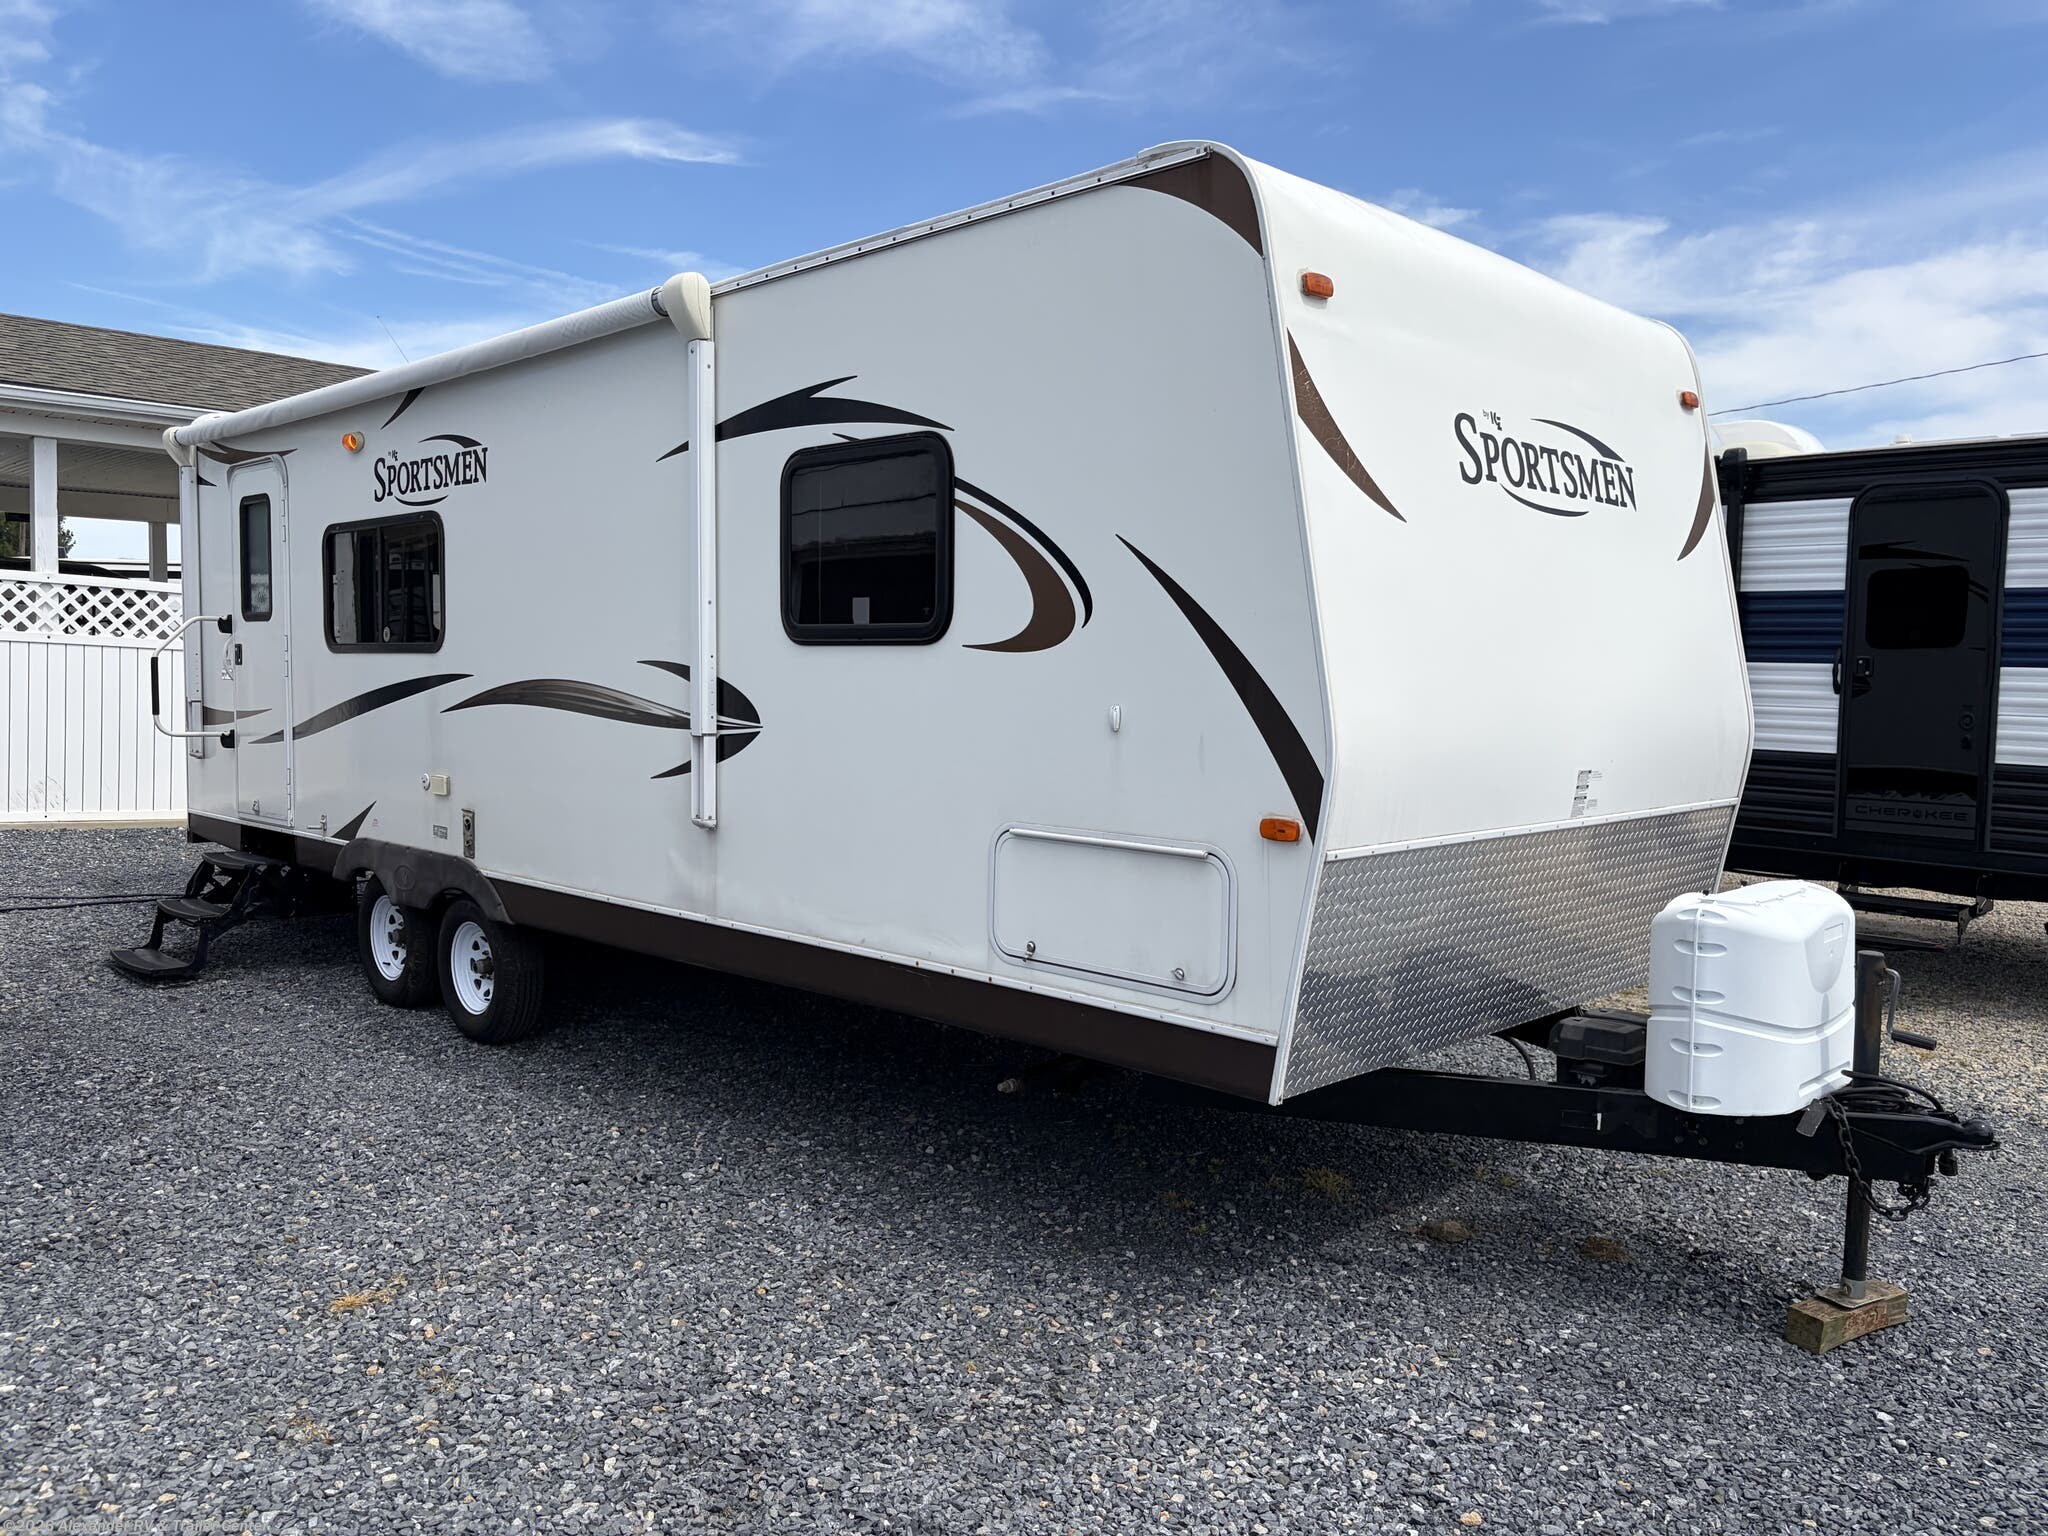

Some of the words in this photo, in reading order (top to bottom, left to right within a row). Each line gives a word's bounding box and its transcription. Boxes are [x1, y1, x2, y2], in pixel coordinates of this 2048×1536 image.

[374, 447, 488, 503] SPORTSMEN
[1454, 412, 1637, 512] SPORTSMEN
[1855, 804, 1969, 822] CHEROKEE
